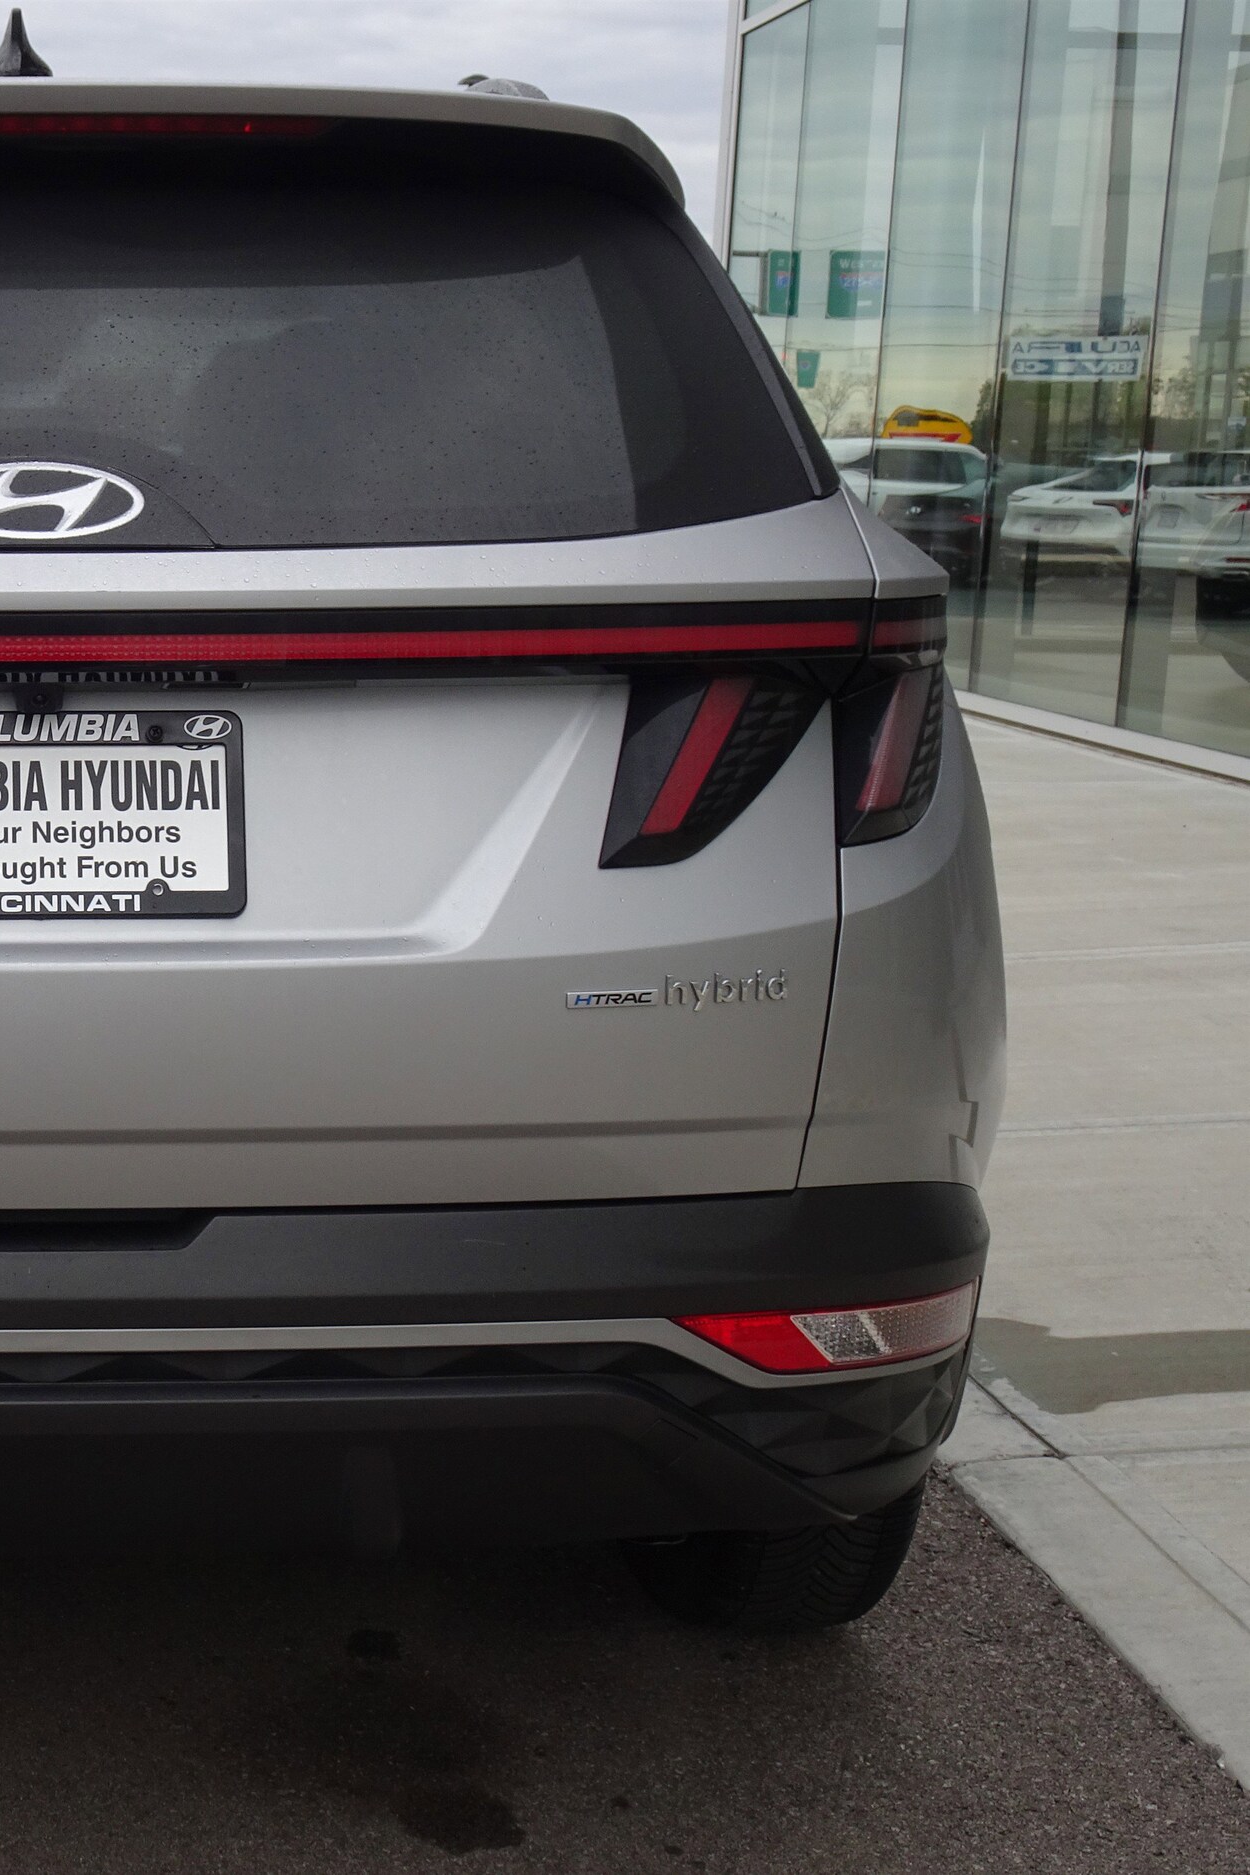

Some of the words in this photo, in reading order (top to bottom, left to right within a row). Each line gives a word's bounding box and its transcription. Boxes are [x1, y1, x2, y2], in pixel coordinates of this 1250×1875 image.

[60, 759, 221, 811] HYUNDAI
[31, 820, 181, 849] Neighbors
[77, 856, 149, 878] From
[160, 855, 198, 878] Us
[574, 992, 653, 1006] HTRAC
[665, 968, 789, 1012] hybrid
